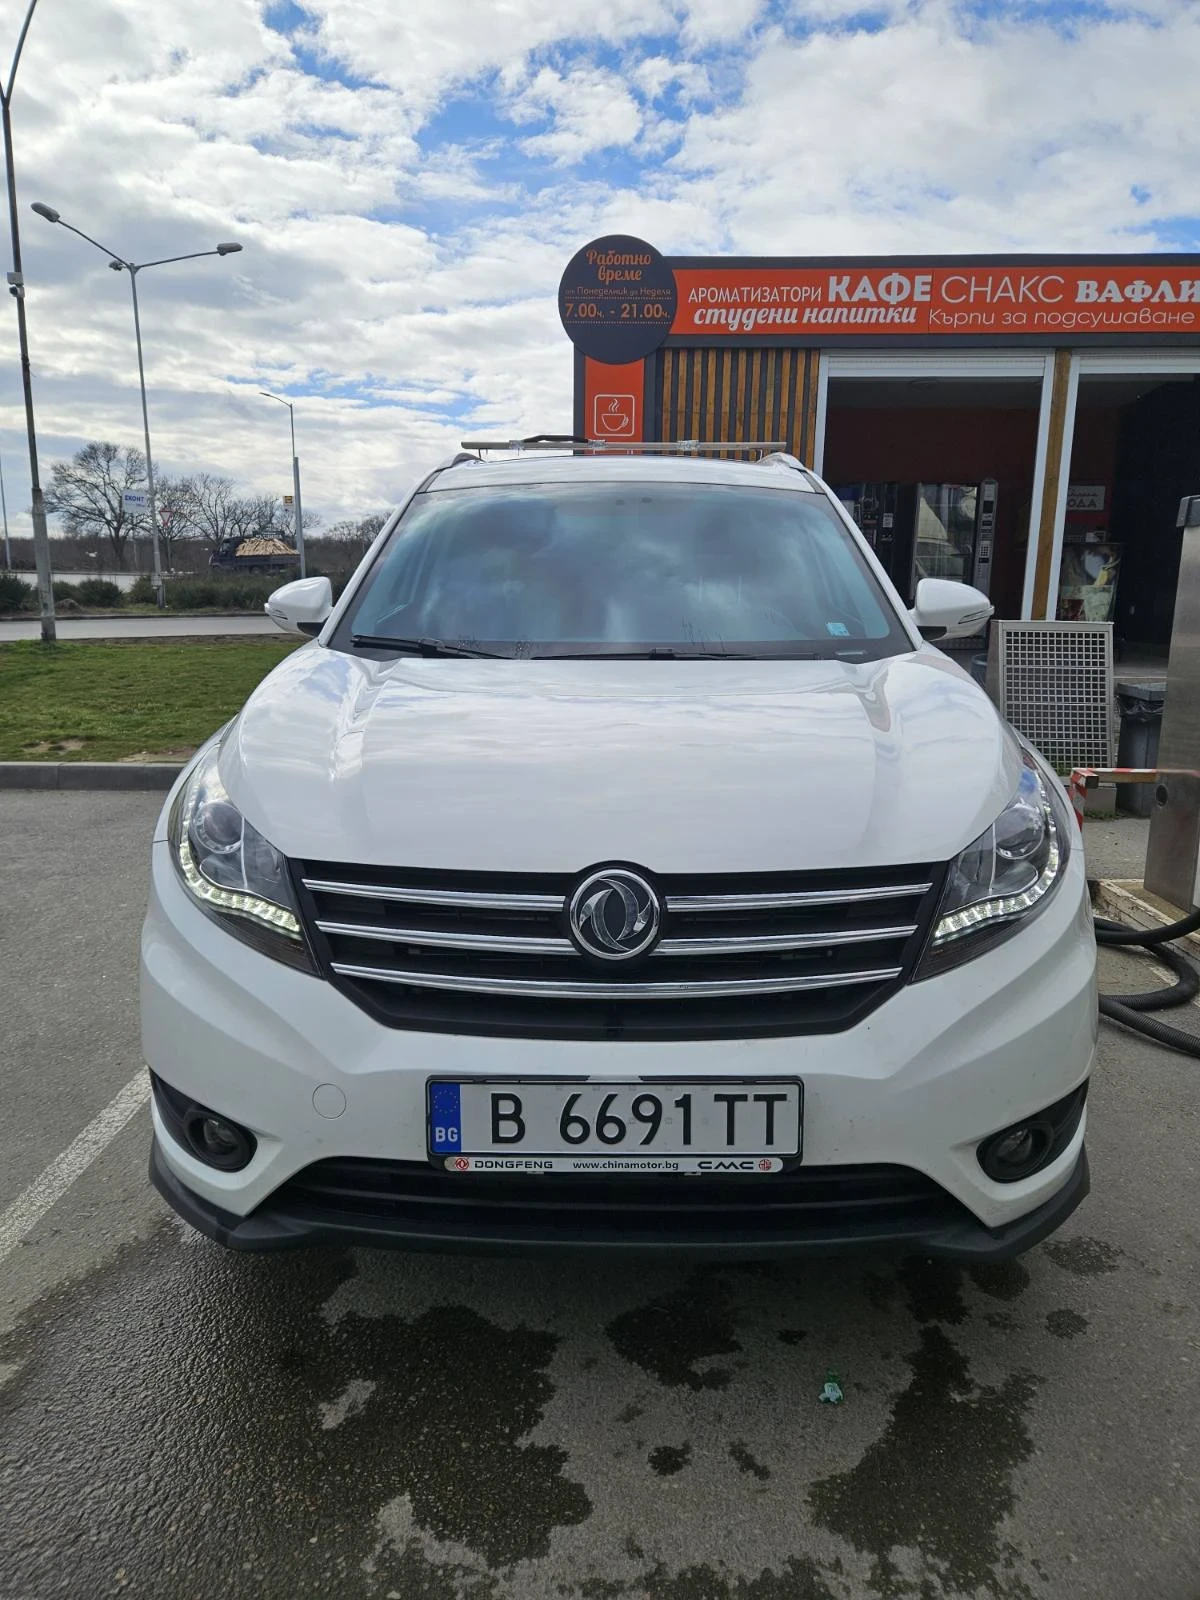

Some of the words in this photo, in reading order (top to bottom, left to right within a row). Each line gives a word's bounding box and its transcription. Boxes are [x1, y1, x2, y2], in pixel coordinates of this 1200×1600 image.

[586, 248, 651, 265] Работно
[598, 265, 642, 285] време
[640, 287, 671, 297] Неделя
[688, 286, 822, 303] АРОМАТИЗАТОРИ
[828, 272, 932, 304] КАФЕ
[941, 275, 1065, 303] СНАКС
[1075, 279, 1200, 303] ВАФЛИ
[565, 303, 605, 318] 7.00ч.
[621, 303, 671, 318] 21.00ч.
[693, 307, 798, 331] студени
[802, 306, 917, 324] напитки
[929, 309, 995, 328] Кърпи
[1001, 312, 1028, 325] за
[1034, 307, 1195, 328] подсушаване
[1067, 498, 1097, 508] ОДА
[491, 1093, 526, 1144] B
[559, 1093, 692, 1145] 6691
[714, 1093, 787, 1145] TT
[435, 1127, 459, 1142] BG
[474, 1160, 553, 1169] DONGFENG
[572, 1160, 679, 1171] www.chinamotor.bg
